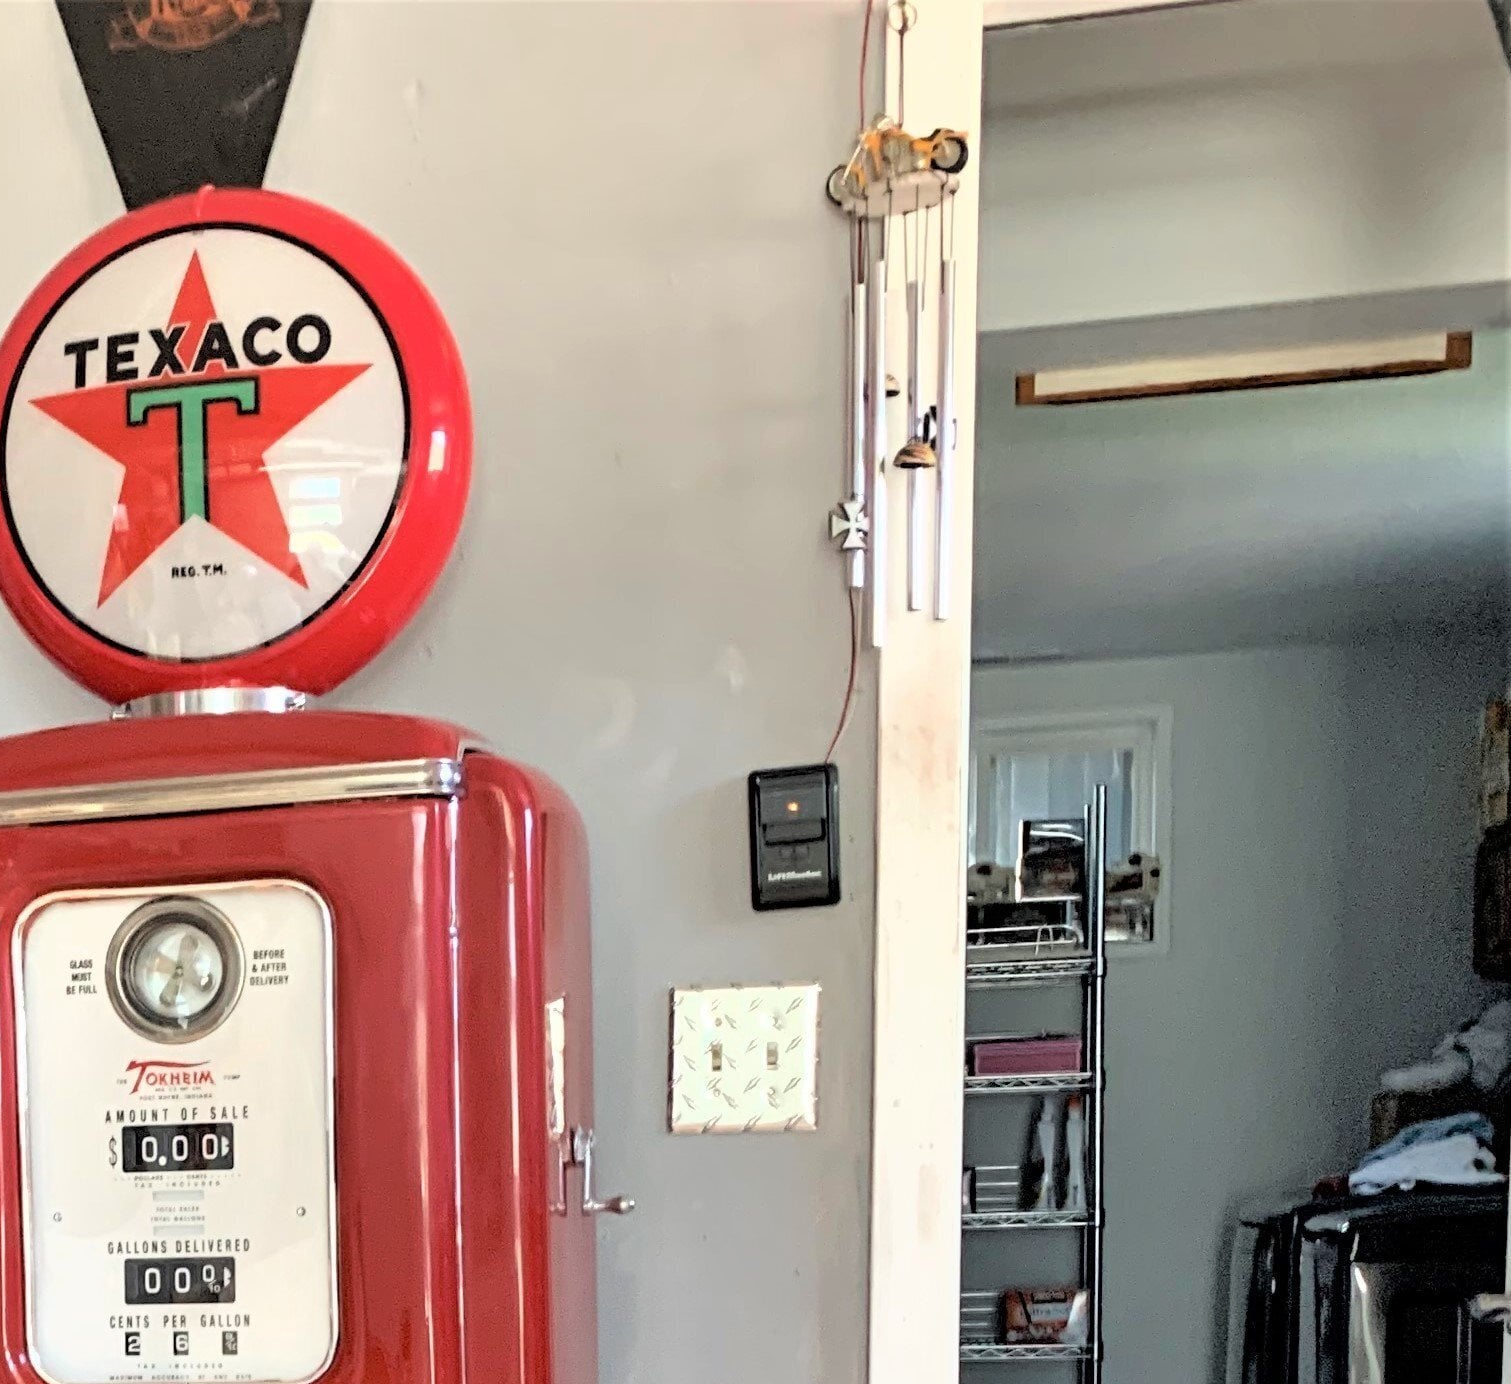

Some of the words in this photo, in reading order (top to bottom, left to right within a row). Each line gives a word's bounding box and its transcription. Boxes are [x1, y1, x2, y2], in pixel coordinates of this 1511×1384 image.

[64, 314, 332, 389] TEXACO
[126, 375, 260, 525] T
[253, 949, 285, 960] BEFORE
[70, 959, 93, 969] GLASS
[261, 962, 287, 972] AFTER
[71, 972, 91, 981] MUST
[250, 975, 289, 986] DELIVERY
[66, 985, 76, 995] BE
[78, 985, 97, 994] FULL
[105, 1109, 169, 1123] AMOUNT
[180, 1107, 198, 1121] OF
[210, 1105, 249, 1120] SALE
[108, 1240, 167, 1254] GALLONS
[175, 1238, 250, 1253] DELIVERED
[109, 1315, 150, 1329] CENTS
[163, 1315, 187, 1328] PER
[200, 1314, 250, 1328] GALLON
